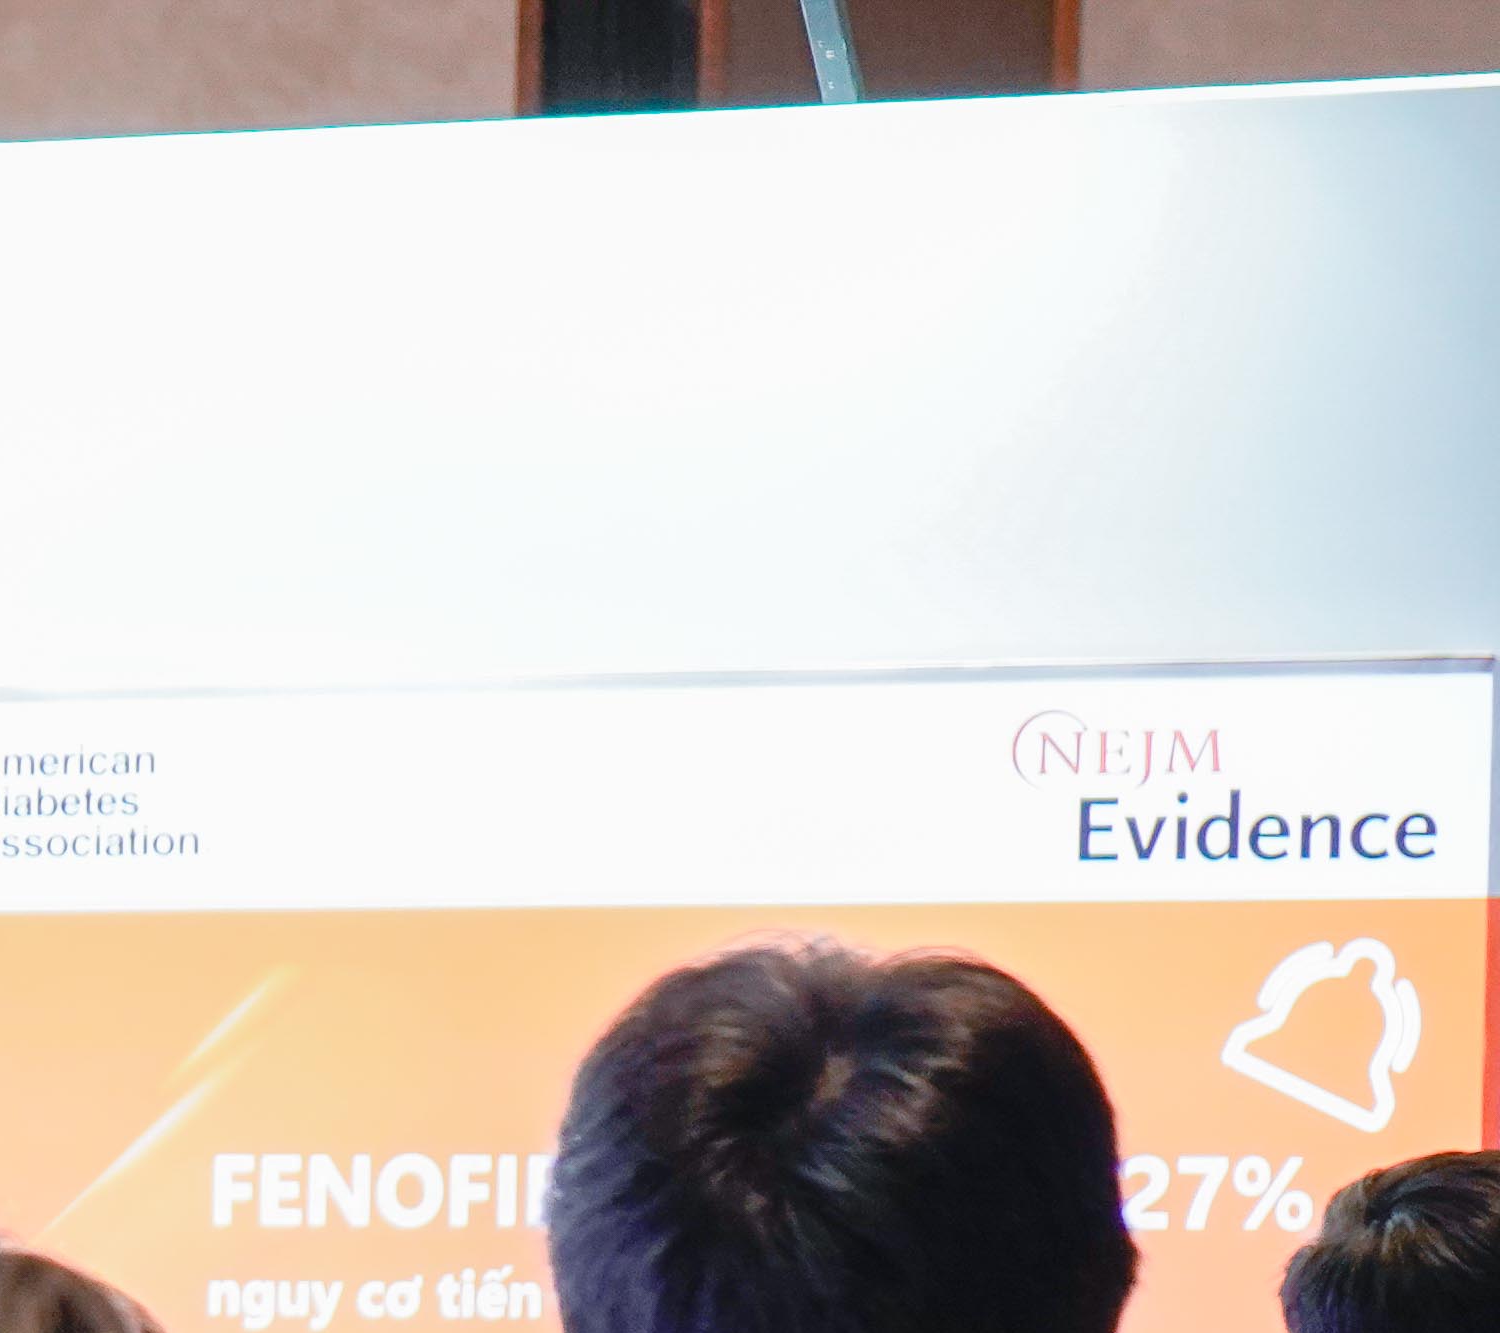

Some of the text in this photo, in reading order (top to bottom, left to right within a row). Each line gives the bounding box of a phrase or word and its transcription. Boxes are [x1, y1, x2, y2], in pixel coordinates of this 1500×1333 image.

[1036, 726, 1224, 788] NEJM
[1078, 788, 1439, 862] Evidence
[1117, 1153, 1315, 1235] 27%
[206, 1263, 545, 1333] nguy cơ tiến
